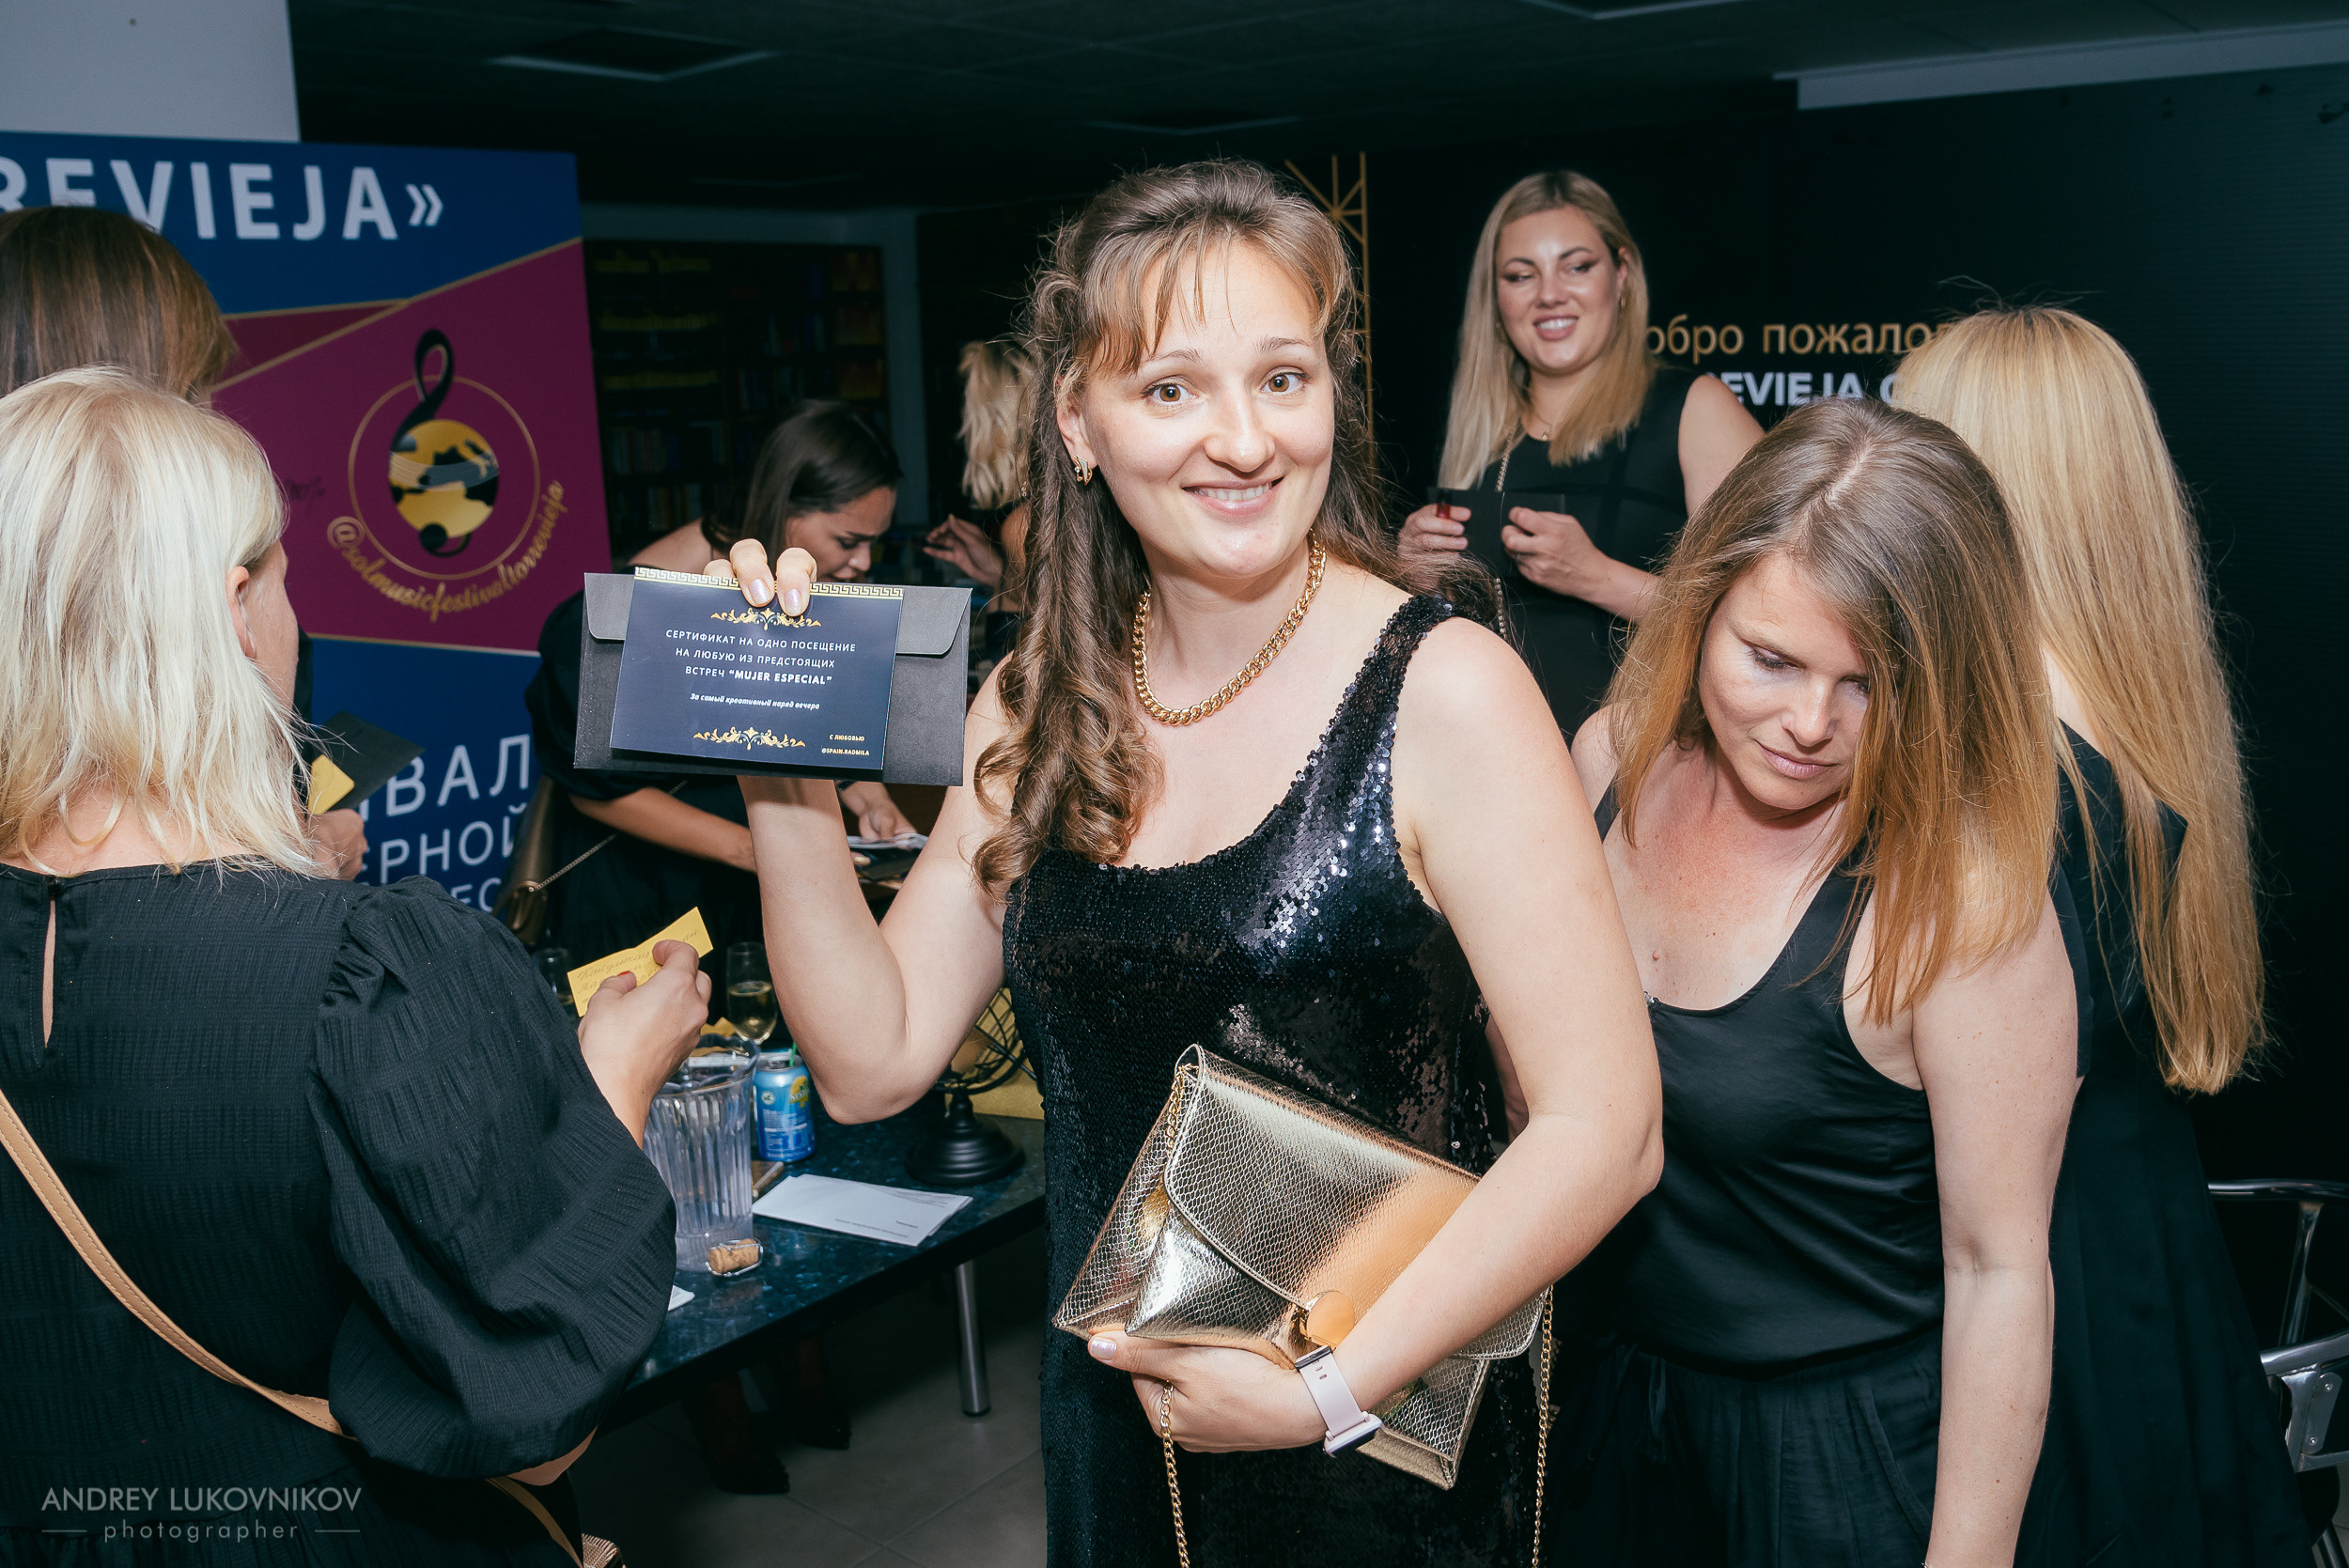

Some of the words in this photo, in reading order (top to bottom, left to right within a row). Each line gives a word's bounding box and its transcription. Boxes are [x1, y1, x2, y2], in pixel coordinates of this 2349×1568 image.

[1763, 322, 1954, 354] пожало
[1706, 371, 1864, 406] EVIEJA
[665, 629, 736, 644] СЕРТИФИКАТ
[739, 637, 754, 646] НА
[756, 638, 787, 649] ОДНО
[790, 640, 856, 653] ПОСЕЩЕНИЕ
[675, 647, 690, 657] НА
[693, 649, 736, 661] ЛЮБУЮ
[739, 654, 754, 663] ИЗ
[756, 655, 835, 669] ПРЕДСТОЯЩИХ
[685, 665, 725, 678] ВСТРЕЧ
[690, 692, 700, 701] За
[700, 693, 725, 703] самый
[725, 696, 772, 706] креативный
[772, 700, 795, 709] наряд
[794, 702, 820, 711] вечера
[834, 734, 865, 742] ЛЮБОВЬЮ
[821, 747, 870, 756] @SPAIN.RADMILA
[359, 734, 530, 822] ВАЛ
[362, 802, 527, 885] РНОЙ
